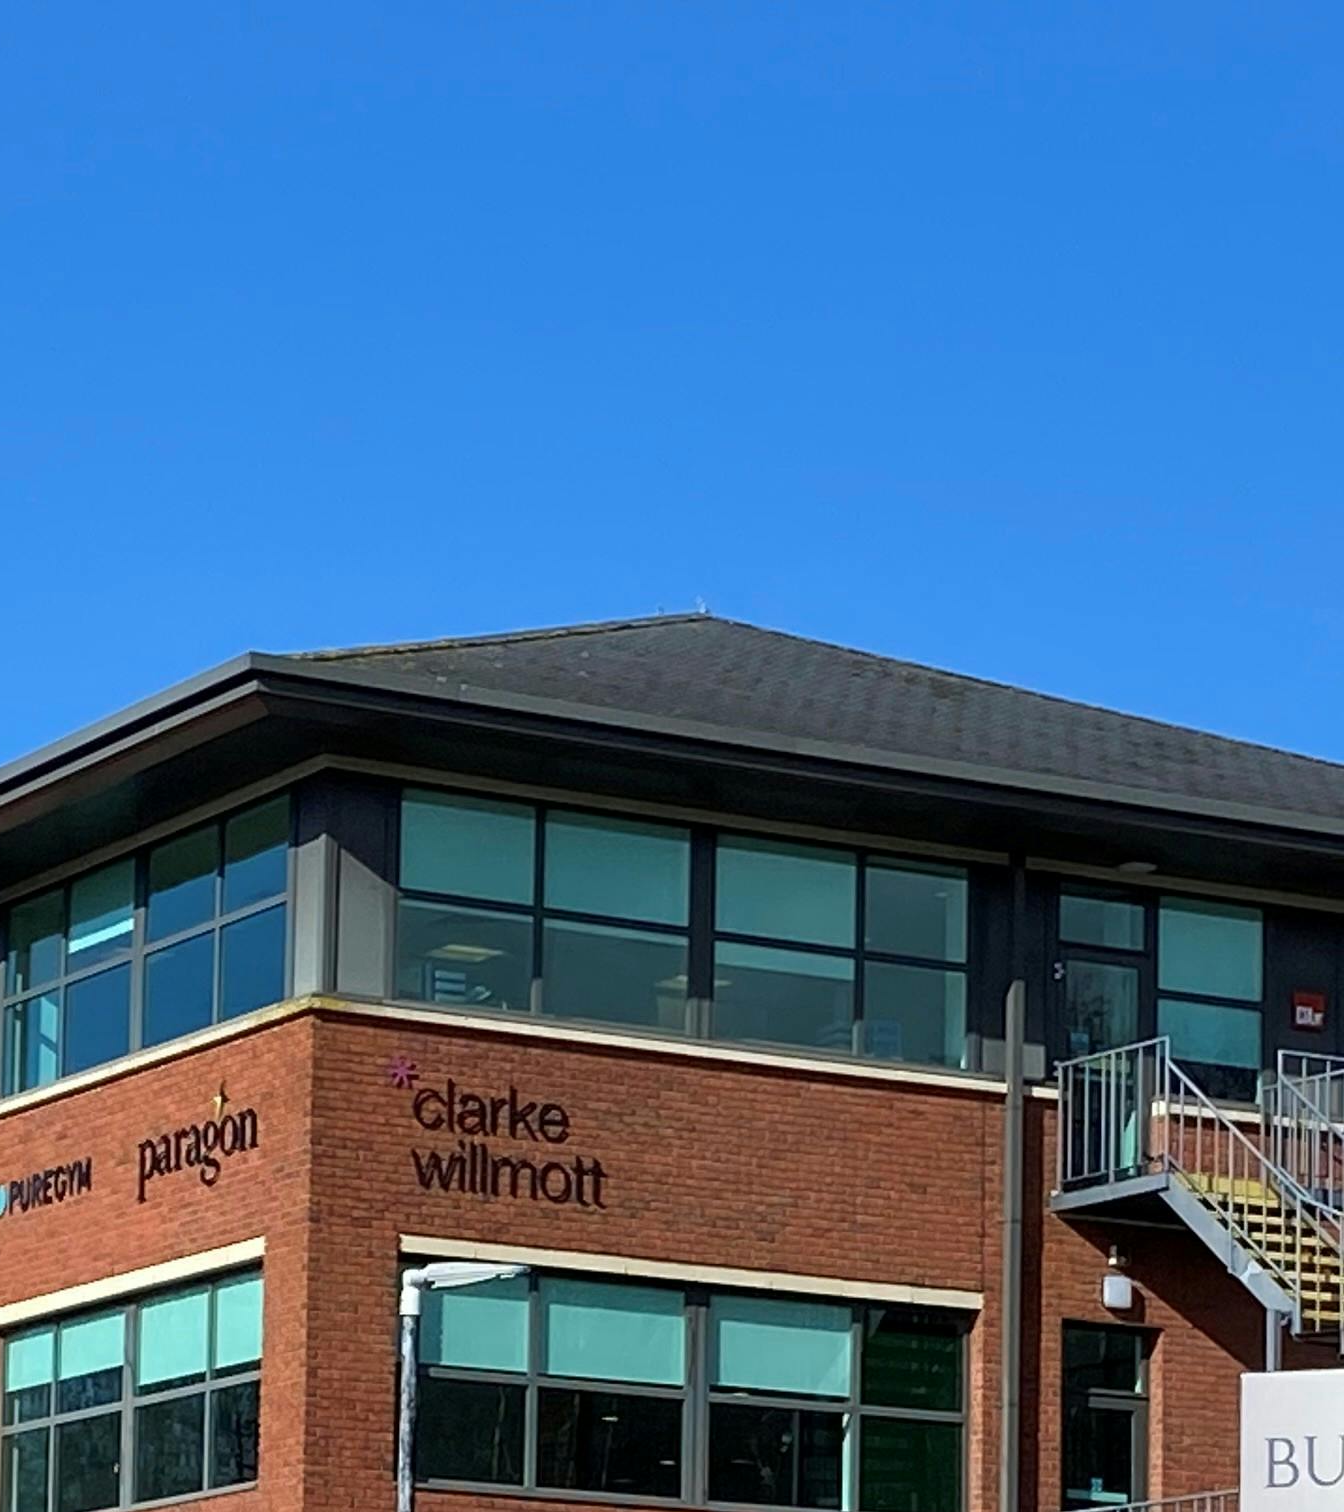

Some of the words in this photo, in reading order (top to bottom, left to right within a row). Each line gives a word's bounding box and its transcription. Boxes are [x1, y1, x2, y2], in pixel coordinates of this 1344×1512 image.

[412, 1079, 570, 1145] clarke
[9, 1157, 93, 1215] PUREGYM
[138, 1106, 259, 1200] paragon
[411, 1141, 608, 1210] willmott
